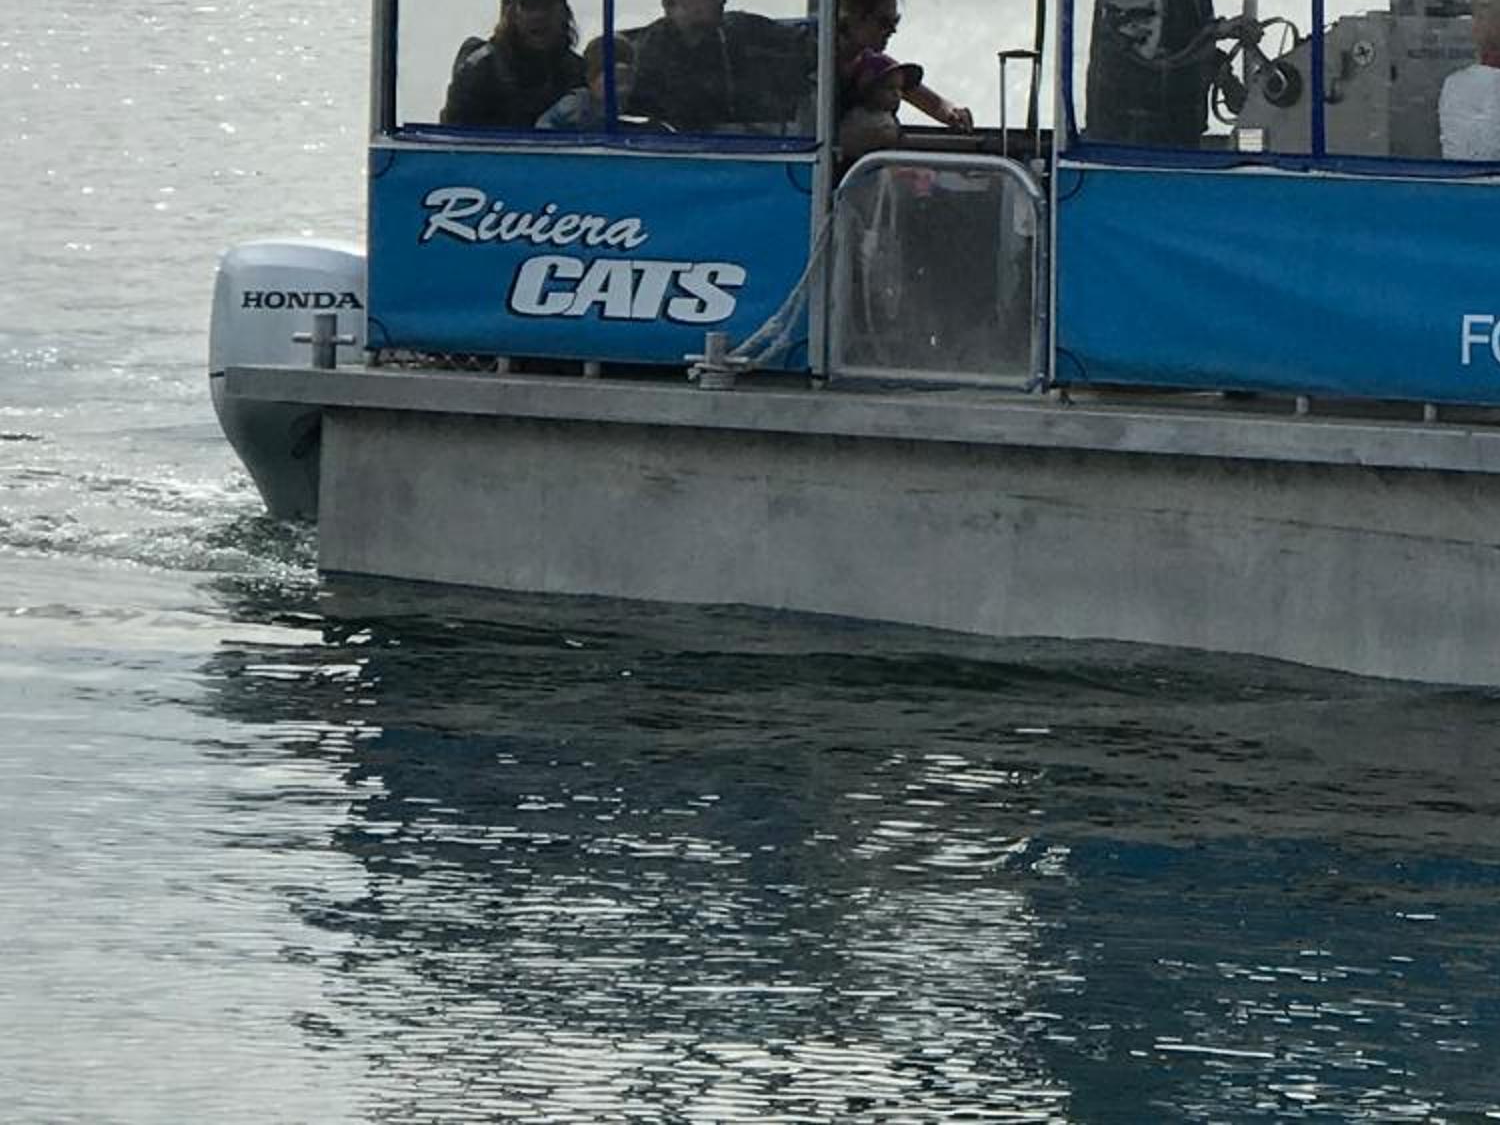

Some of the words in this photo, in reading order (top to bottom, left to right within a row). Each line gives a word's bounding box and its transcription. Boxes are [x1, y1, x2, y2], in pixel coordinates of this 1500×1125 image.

[420, 185, 650, 249] Riviera
[241, 291, 364, 309] HONDA
[509, 254, 747, 323] CATS
